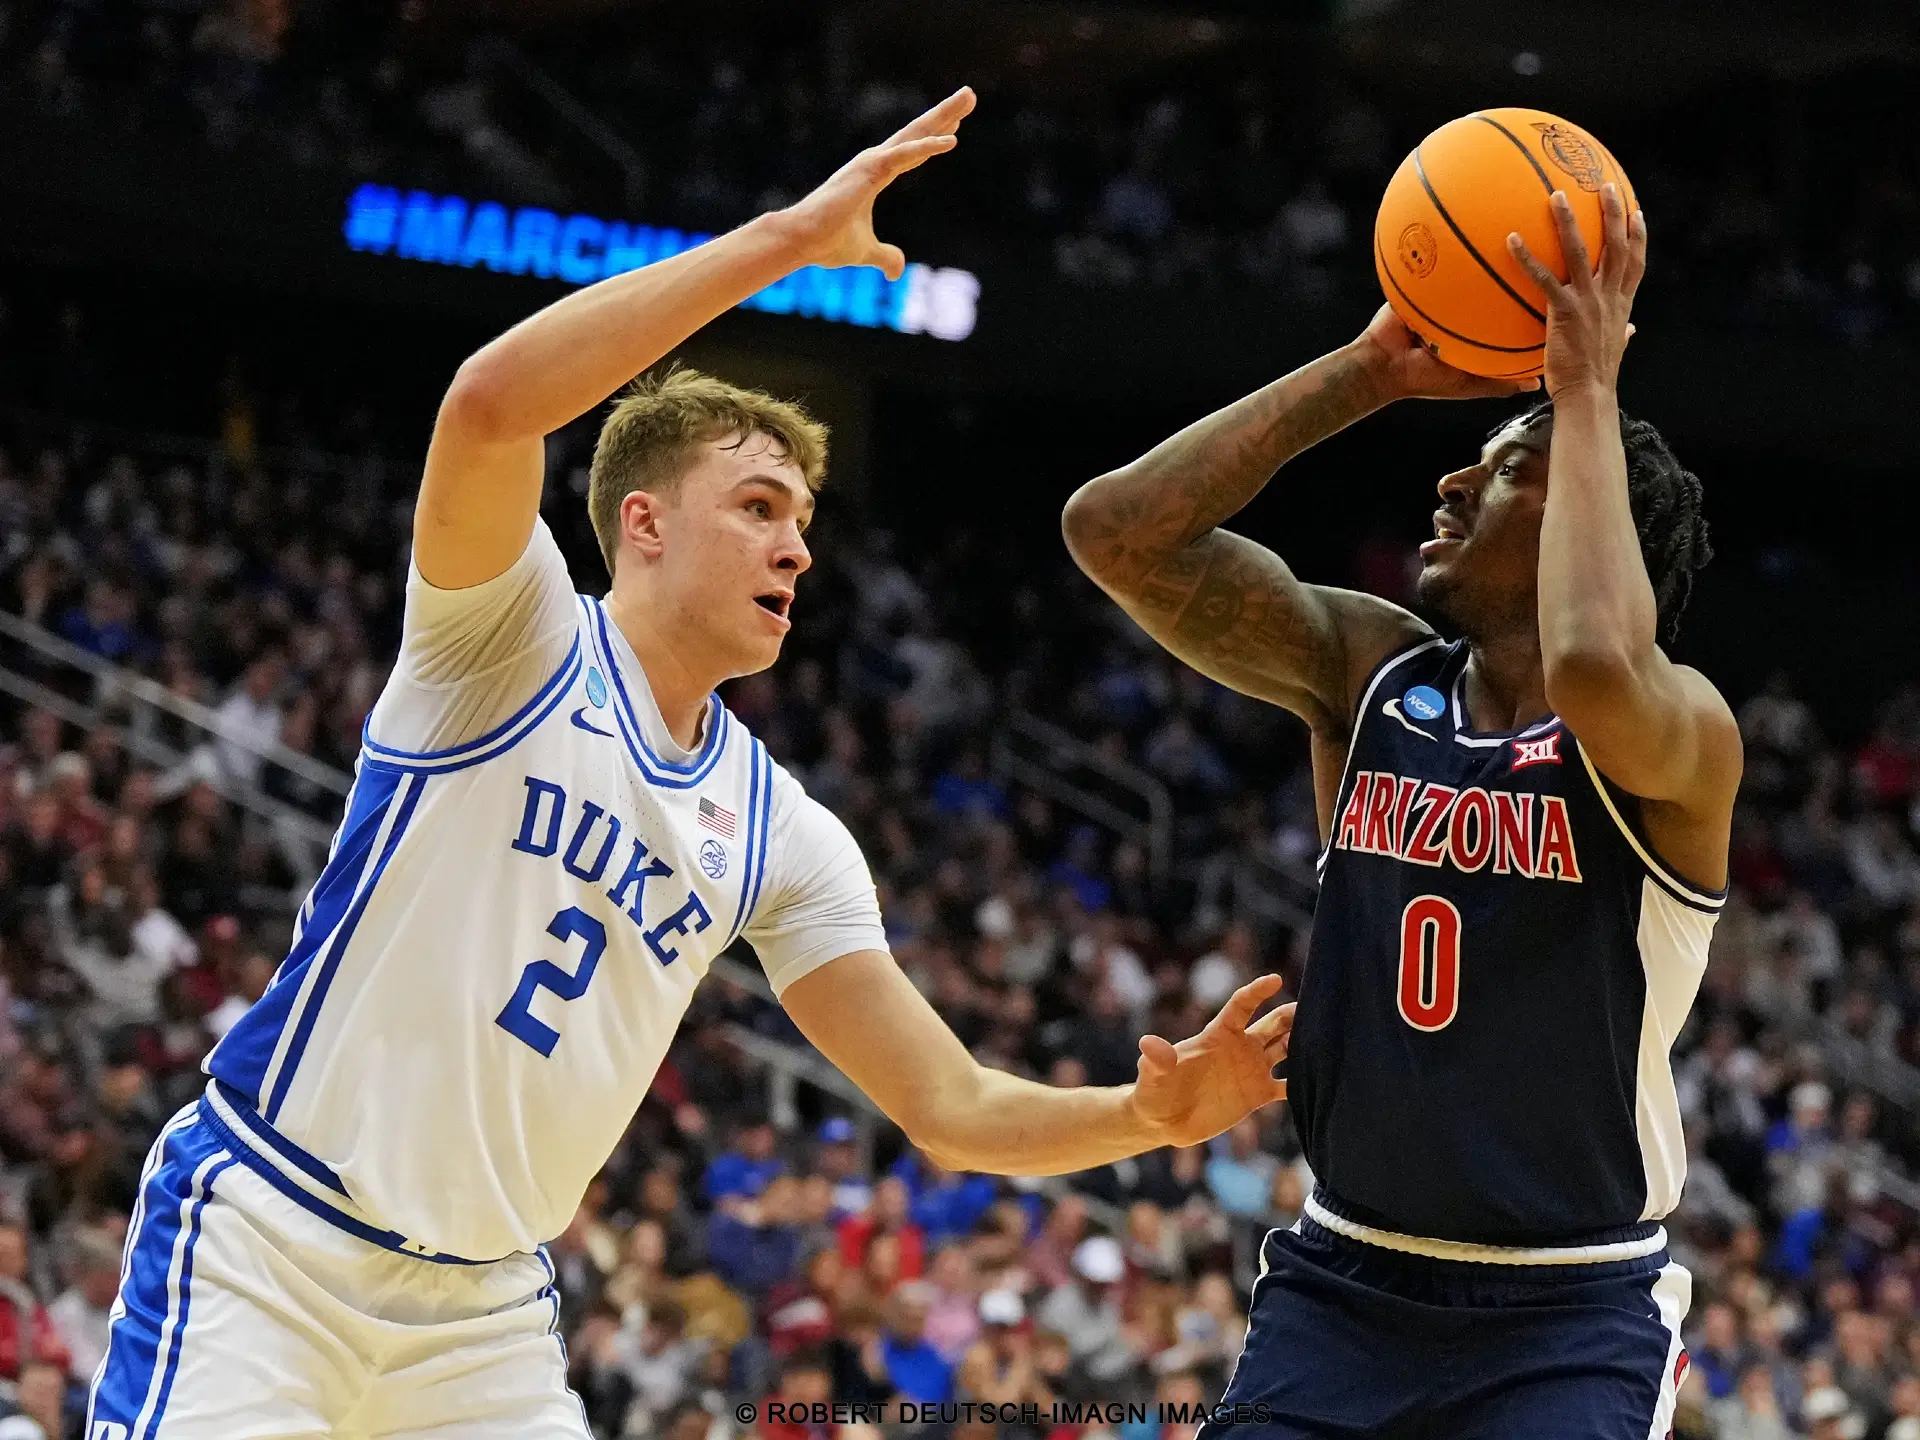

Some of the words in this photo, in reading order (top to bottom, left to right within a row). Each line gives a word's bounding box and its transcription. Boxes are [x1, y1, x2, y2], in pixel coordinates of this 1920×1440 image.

[1407, 694, 1438, 718] NCAA
[1514, 734, 1559, 766] XII
[511, 775, 713, 967] DUKE
[702, 851, 727, 869] ACC
[1335, 770, 1583, 883] ARIZONA
[495, 905, 607, 1059] 2
[1397, 894, 1462, 1032] 0
